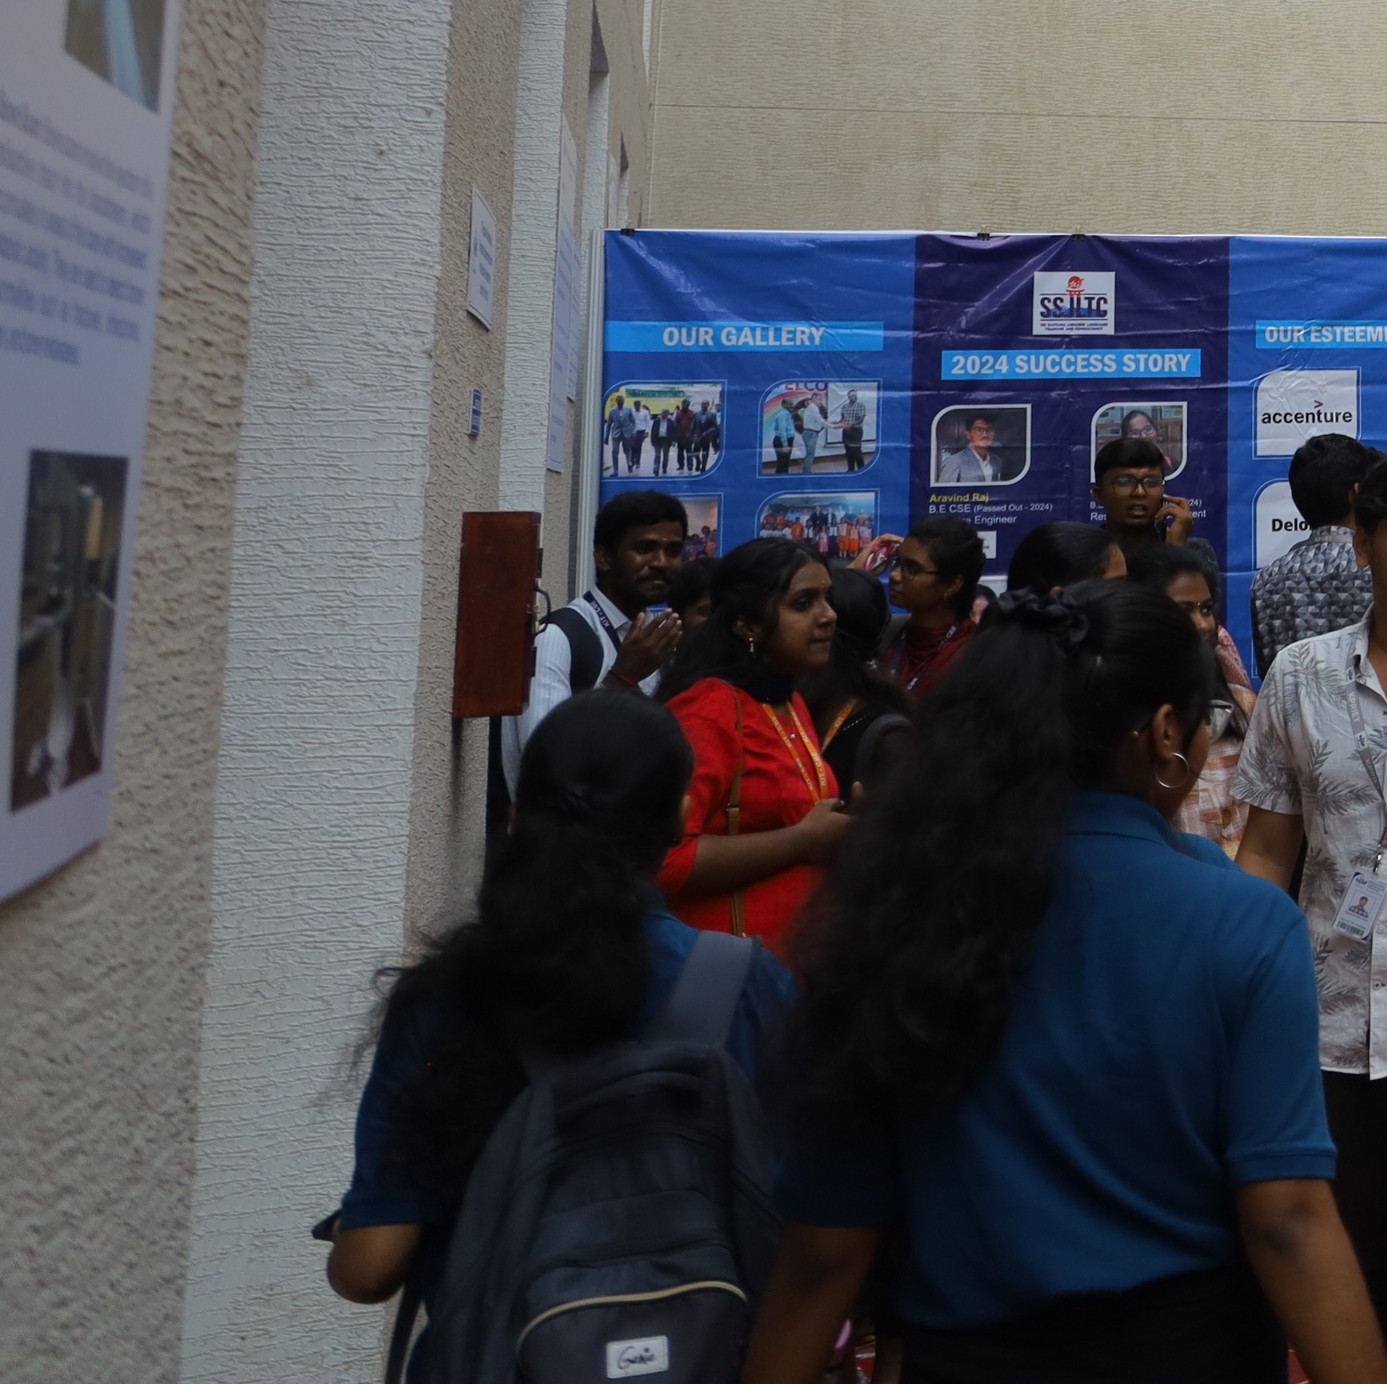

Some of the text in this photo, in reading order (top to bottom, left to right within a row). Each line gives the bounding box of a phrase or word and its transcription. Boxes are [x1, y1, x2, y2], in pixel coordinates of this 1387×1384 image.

[663, 326, 826, 346] OUR GALLERY
[1264, 326, 1306, 343] OUR
[951, 353, 1191, 374] 2024 SUCCESS STORY
[1261, 409, 1352, 424] accenture
[930, 493, 989, 502] Aravind Raj
[929, 504, 946, 513] B.E
[949, 504, 971, 513] CSE
[974, 504, 1006, 513] (Passed
[1030, 503, 1053, 512] 2024)
[974, 516, 1017, 526] Engineer
[1272, 518, 1312, 532] Delo
